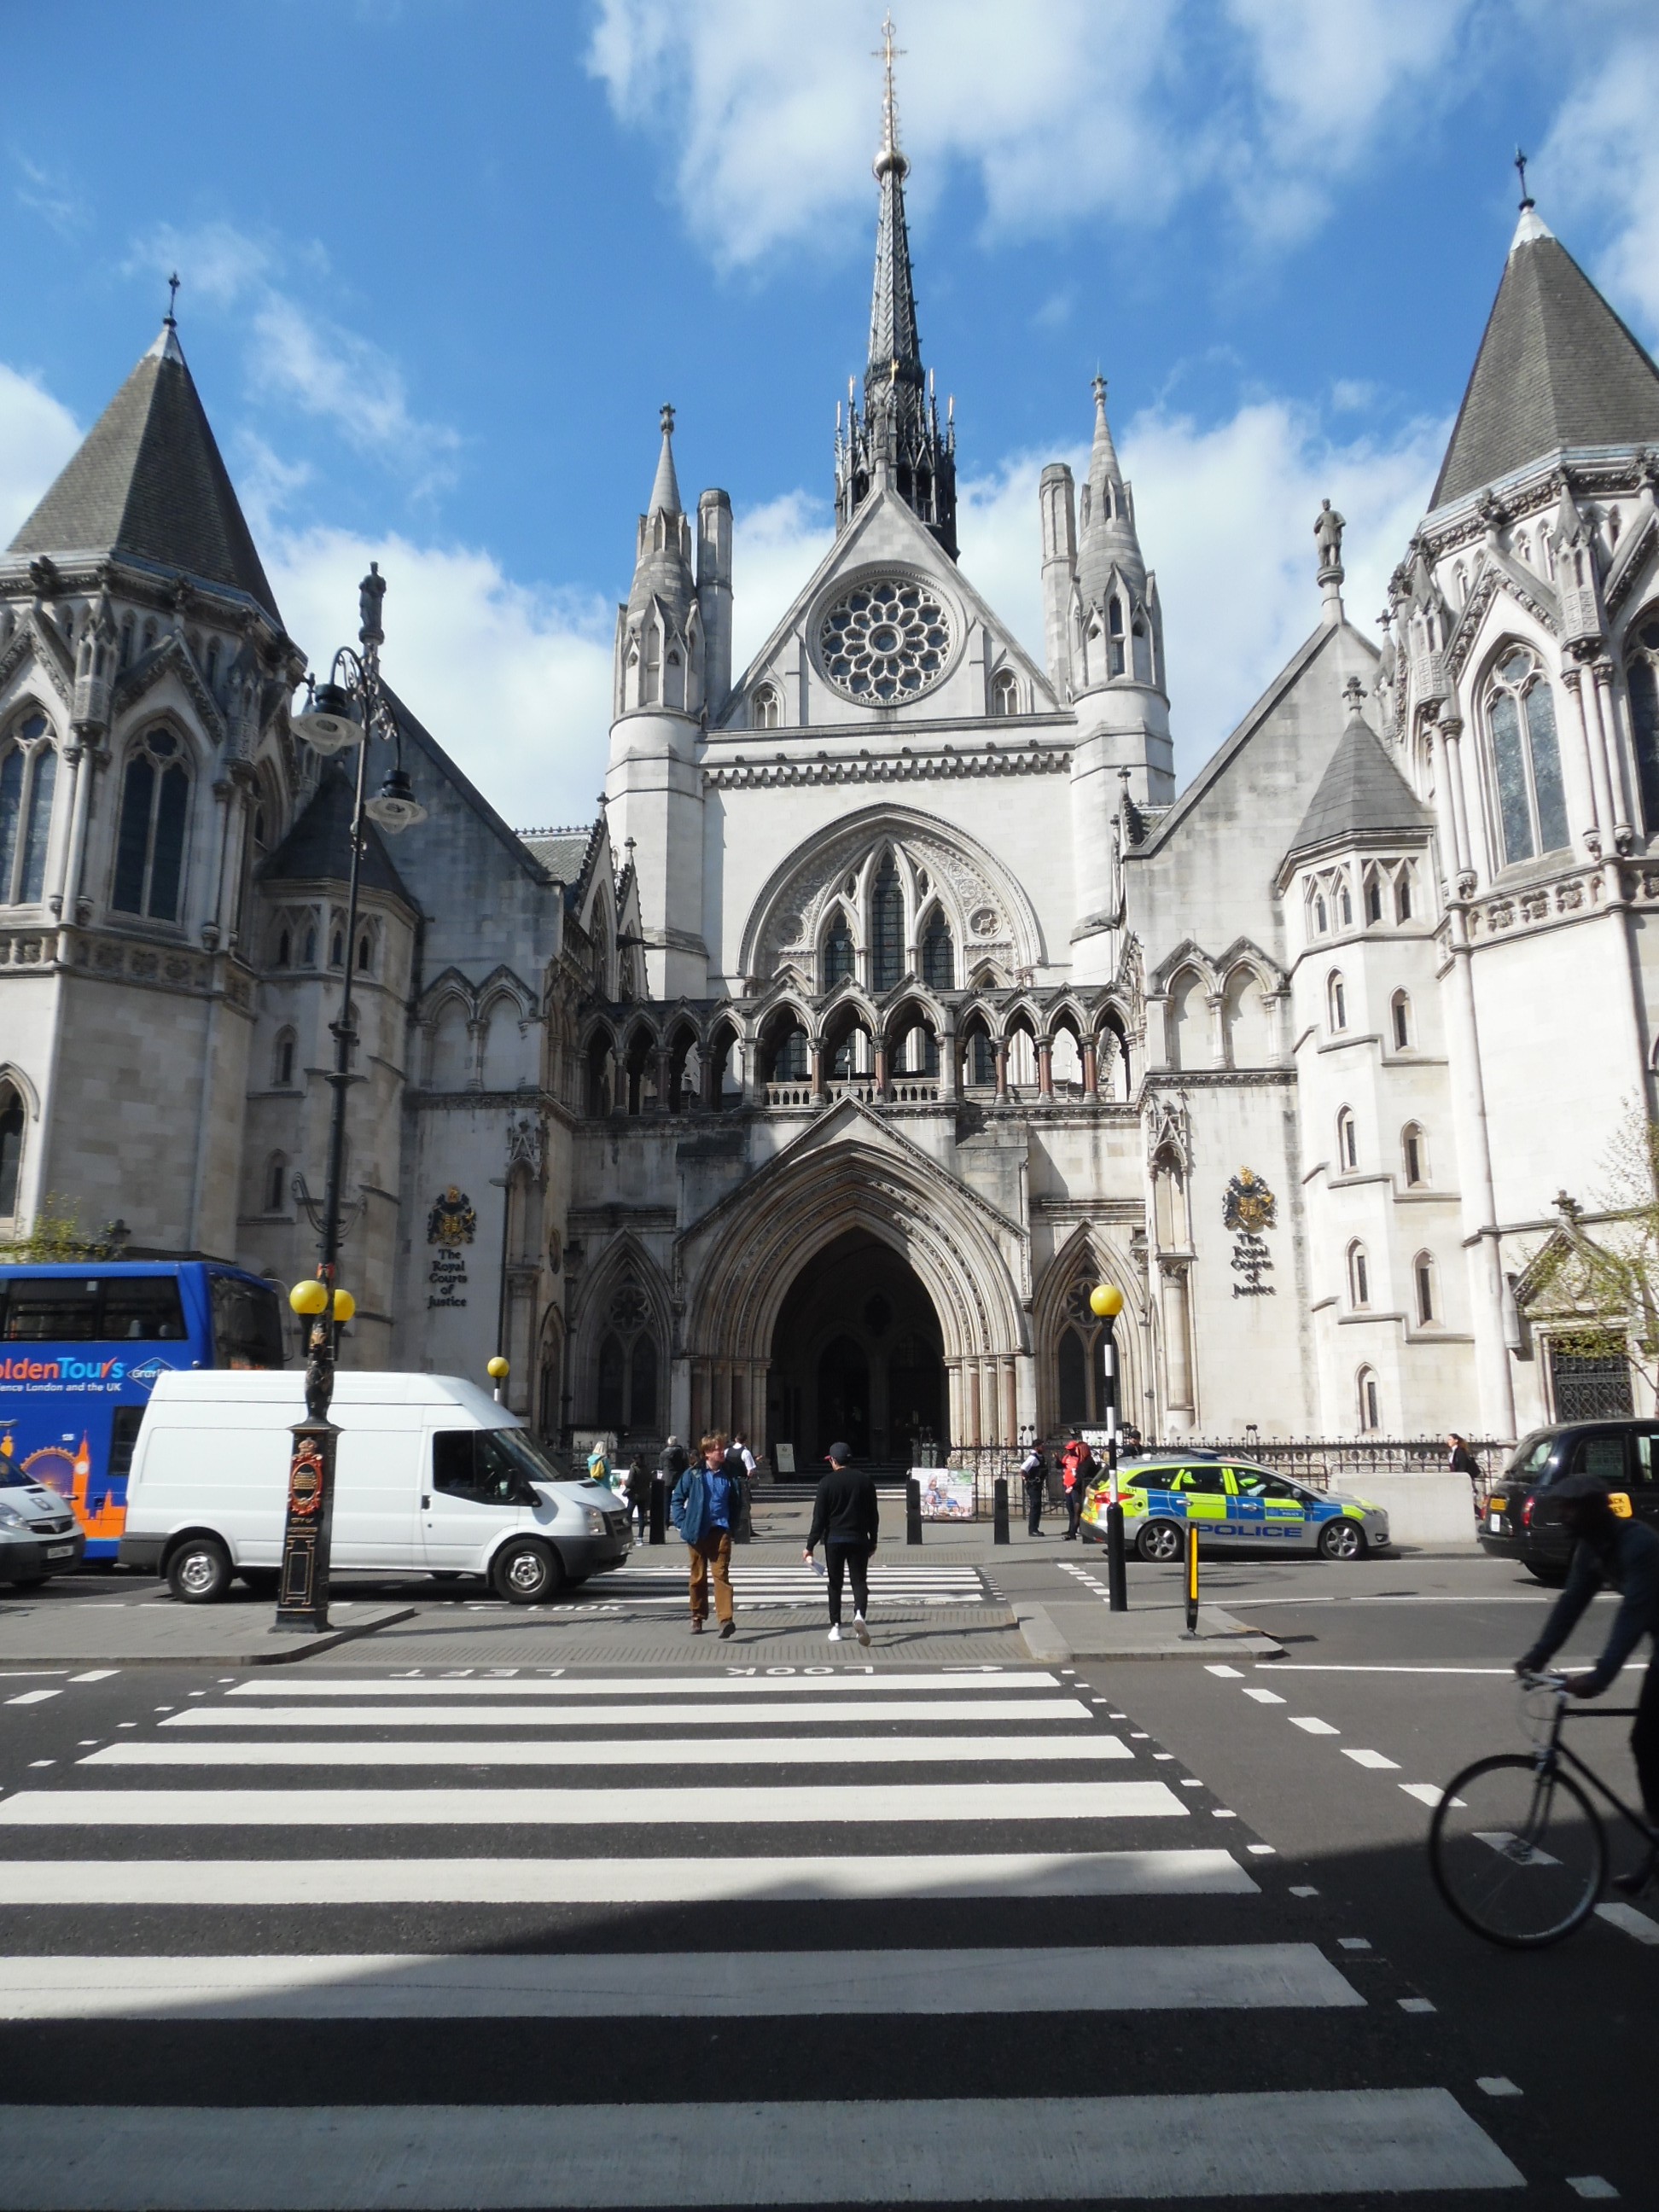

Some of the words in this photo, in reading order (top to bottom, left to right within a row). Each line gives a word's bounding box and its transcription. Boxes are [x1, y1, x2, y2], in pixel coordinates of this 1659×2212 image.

[1237, 1233, 1263, 1246] The
[438, 1249, 462, 1260] The
[1232, 1245, 1270, 1260] Royal
[432, 1260, 465, 1273] Royal
[1231, 1259, 1274, 1272] Courts
[428, 1272, 468, 1284] Courts
[1245, 1270, 1261, 1284] of
[440, 1284, 454, 1295] of
[1231, 1283, 1276, 1299] Justice
[428, 1295, 467, 1309] Justice
[26, 1382, 63, 1392] London
[66, 1382, 85, 1392] and
[87, 1382, 104, 1391] the
[106, 1382, 122, 1391] UK
[1198, 1523, 1302, 1538] POLICE
[725, 1666, 875, 1676] LOOK
